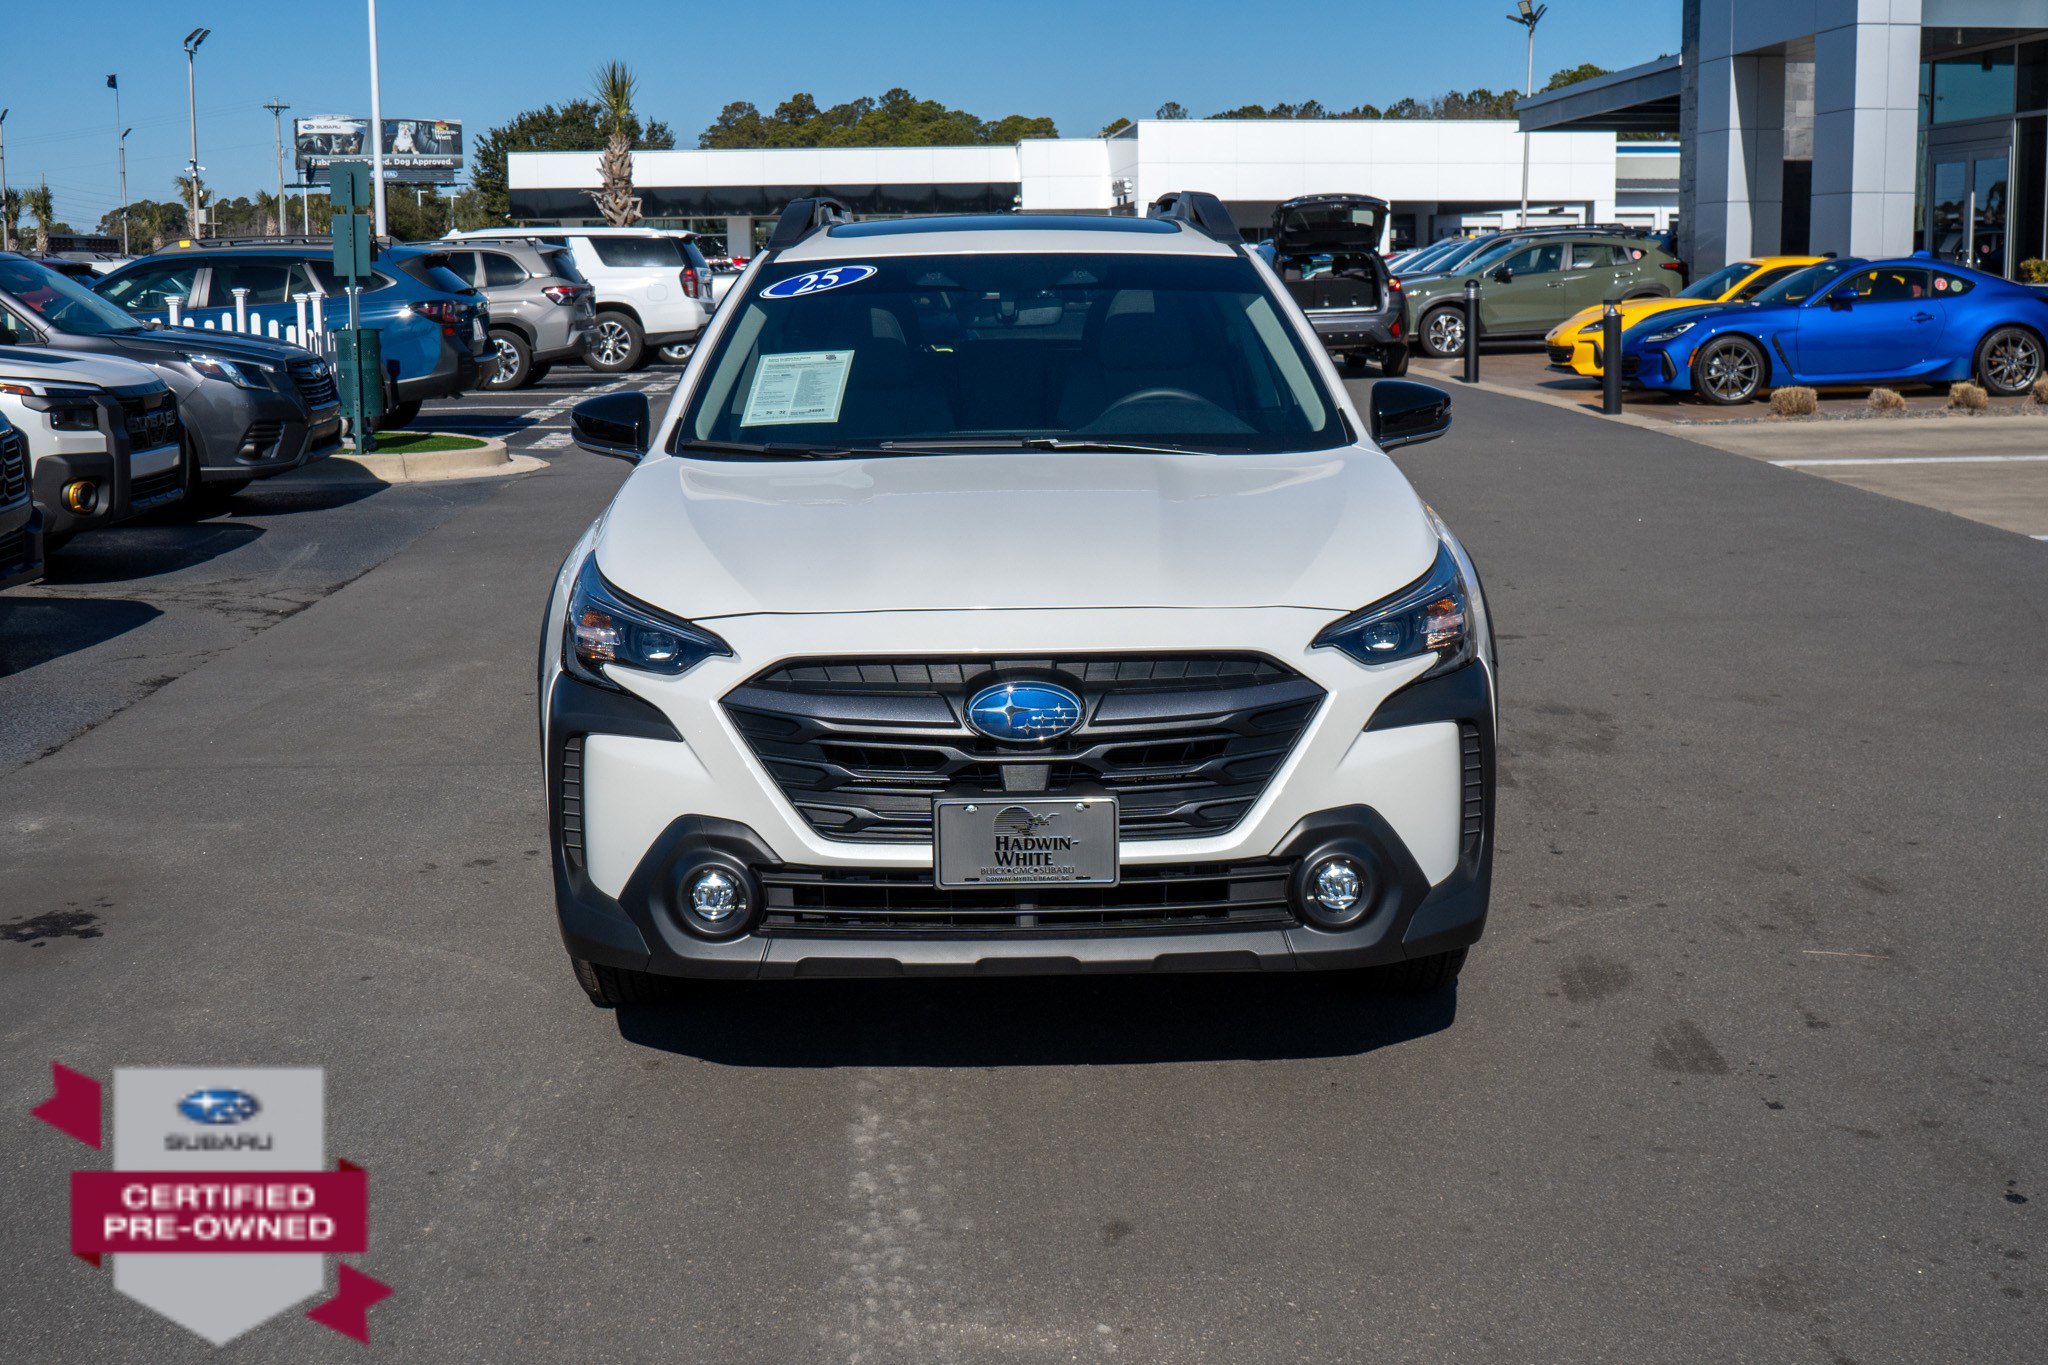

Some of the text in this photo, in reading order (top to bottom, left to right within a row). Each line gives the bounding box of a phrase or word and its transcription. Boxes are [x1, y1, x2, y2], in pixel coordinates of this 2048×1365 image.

[394, 158, 410, 167] Dog
[412, 158, 454, 167] Approved.
[793, 267, 845, 295] 25
[995, 851, 1053, 867] WHITE
